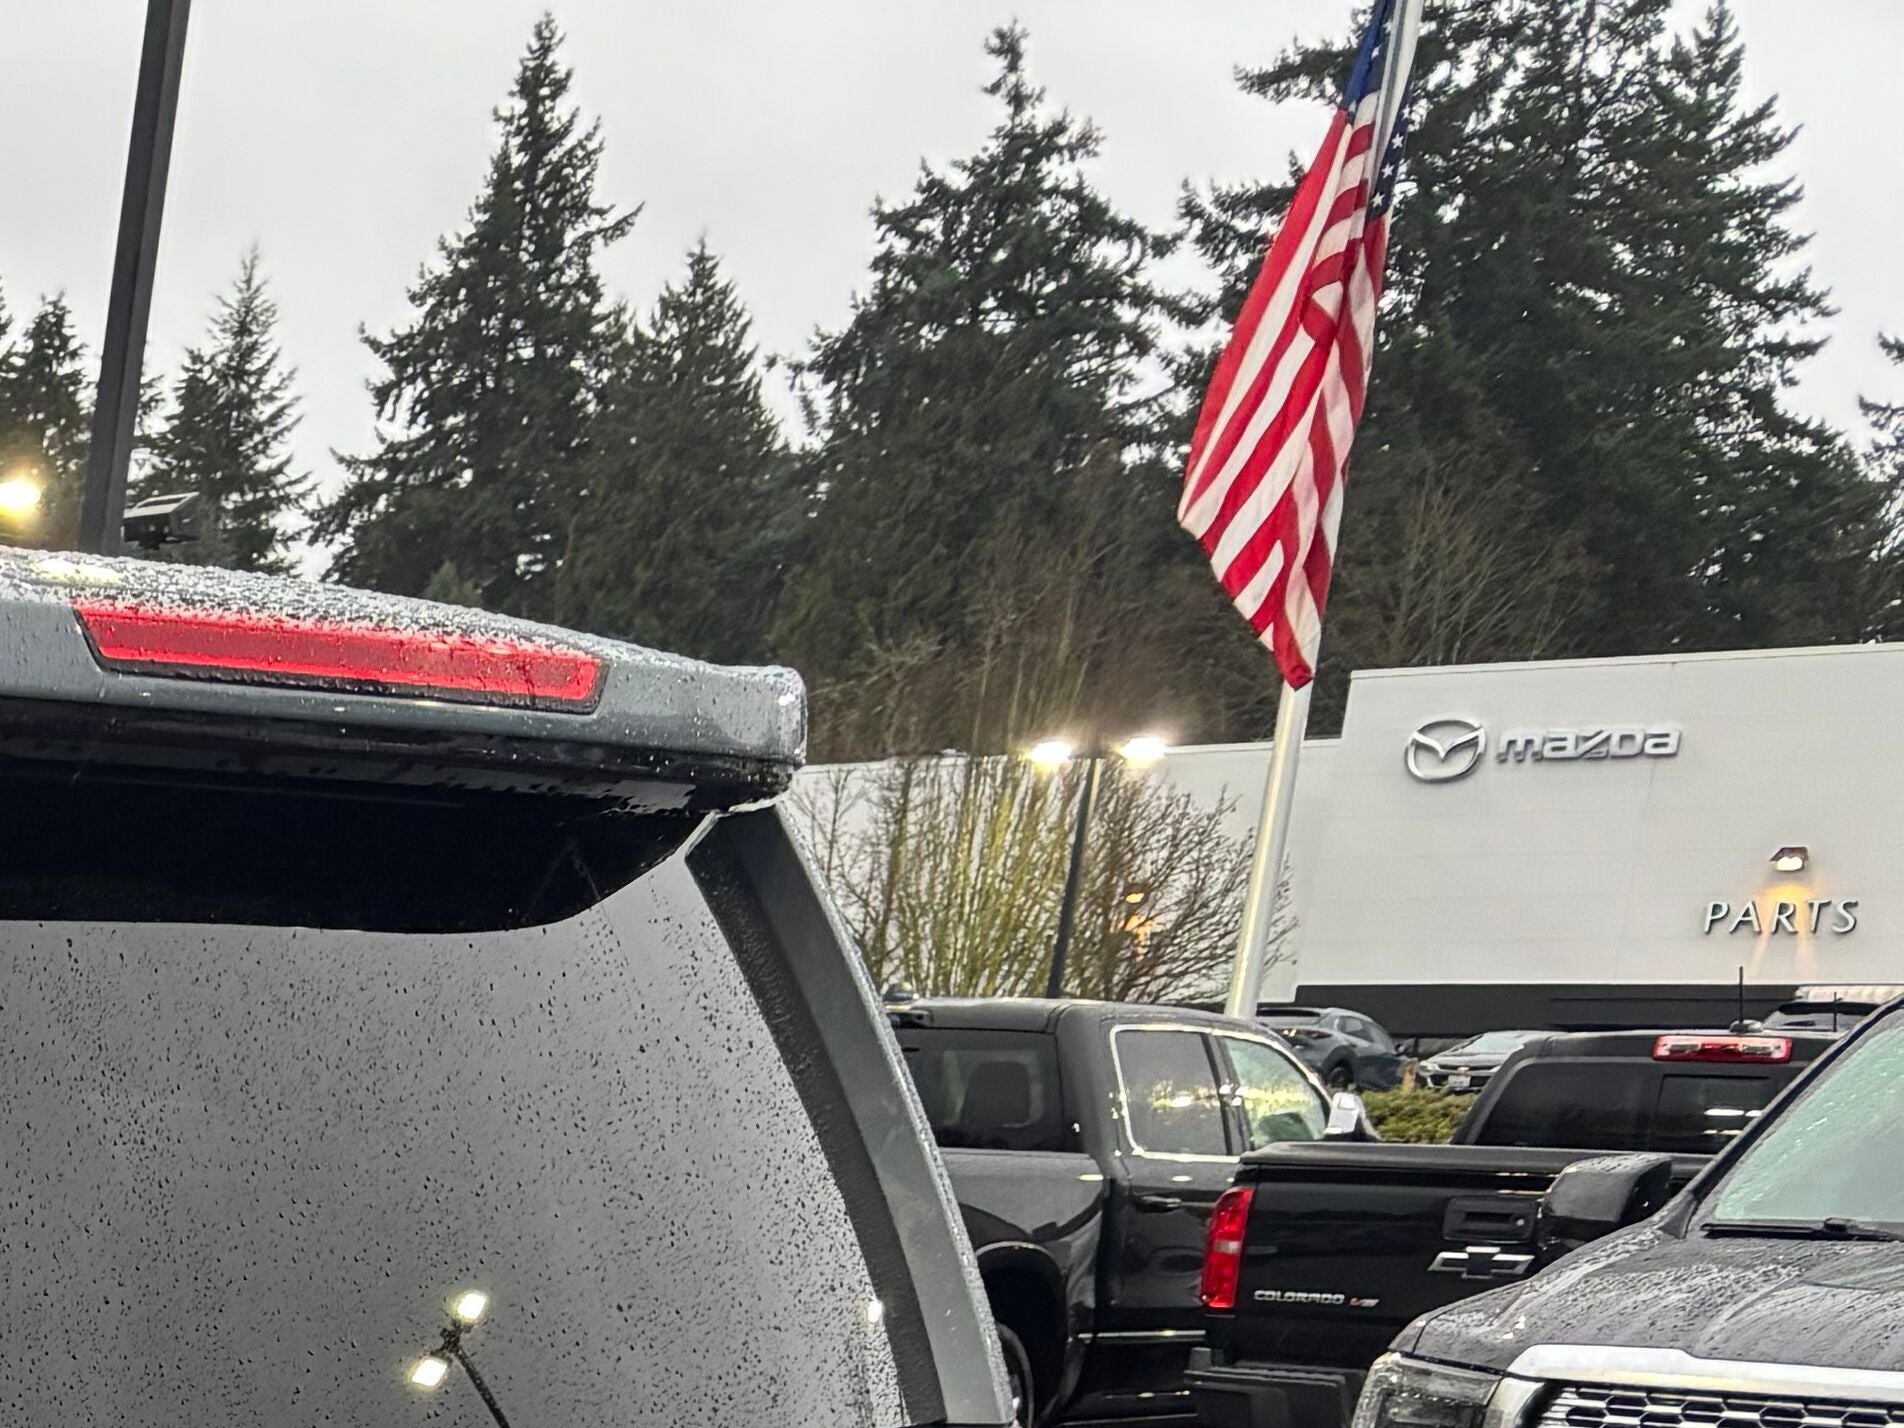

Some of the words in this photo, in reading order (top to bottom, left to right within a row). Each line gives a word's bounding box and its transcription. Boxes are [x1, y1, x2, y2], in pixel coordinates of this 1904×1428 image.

[1495, 727, 1682, 764] mazda
[1704, 899, 1860, 937] PARTS
[1253, 1289, 1345, 1305] COLORADO
